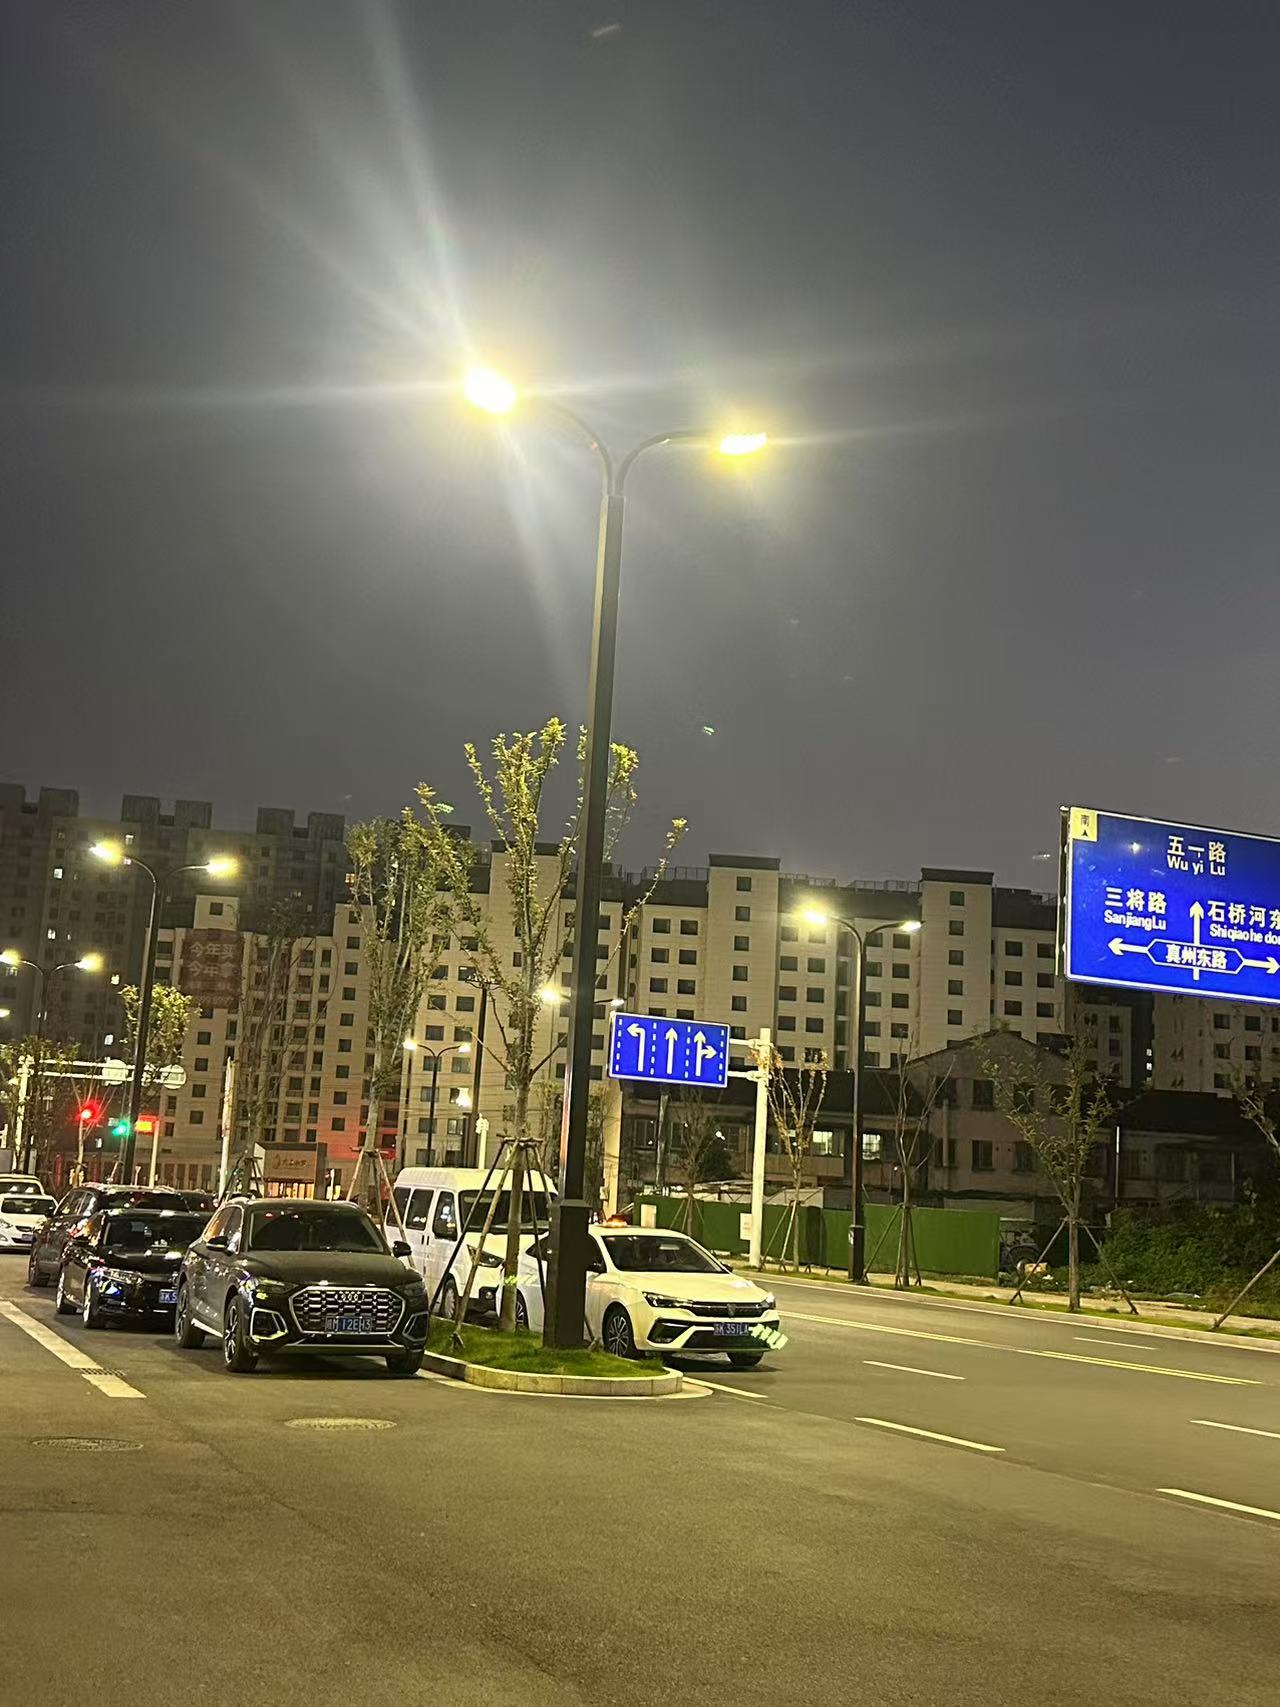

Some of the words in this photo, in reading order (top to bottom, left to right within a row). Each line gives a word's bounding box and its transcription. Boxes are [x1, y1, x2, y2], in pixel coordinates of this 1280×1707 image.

[1080, 814, 1090, 827] 南
[1167, 835, 1226, 863] 五一路
[1167, 855, 1188, 871] Wu
[1192, 860, 1204, 875] yi
[1209, 862, 1226, 876] Lu
[1104, 887, 1167, 915] 三将路
[1165, 943, 1228, 970] 真州东路
